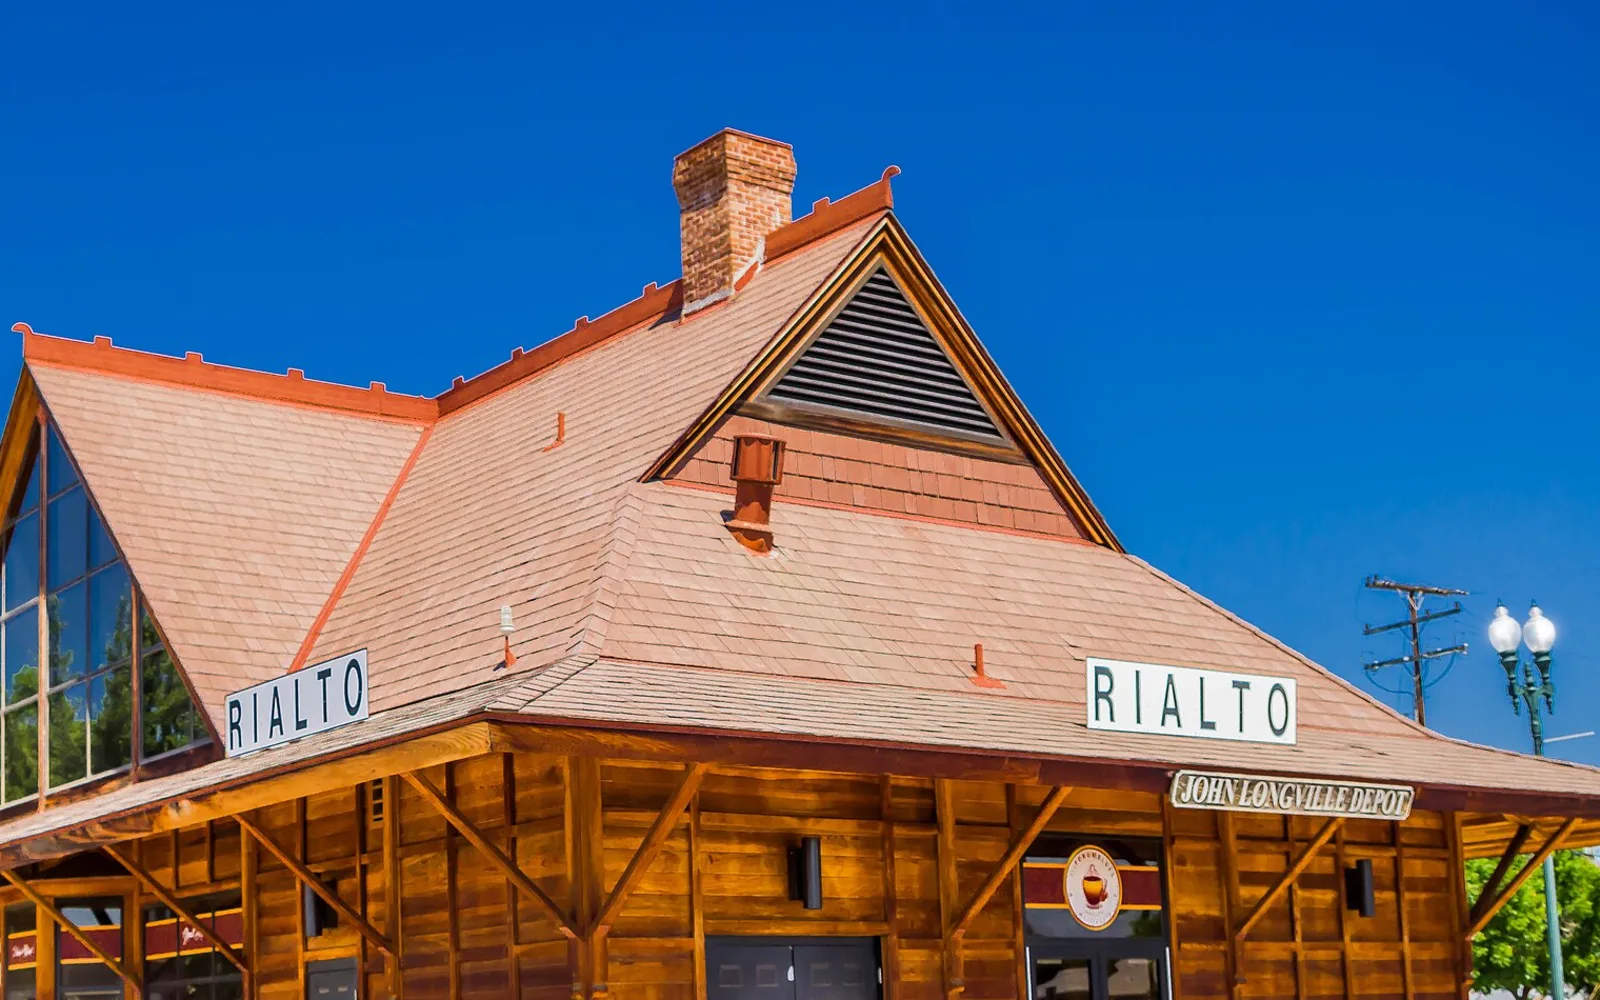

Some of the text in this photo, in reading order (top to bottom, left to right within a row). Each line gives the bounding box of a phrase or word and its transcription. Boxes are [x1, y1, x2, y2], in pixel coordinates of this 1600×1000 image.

[229, 658, 363, 750] RIALTO
[1094, 665, 1289, 737] RIALTO
[1180, 774, 1411, 817] JOHN LONGVILLE DEPOT
